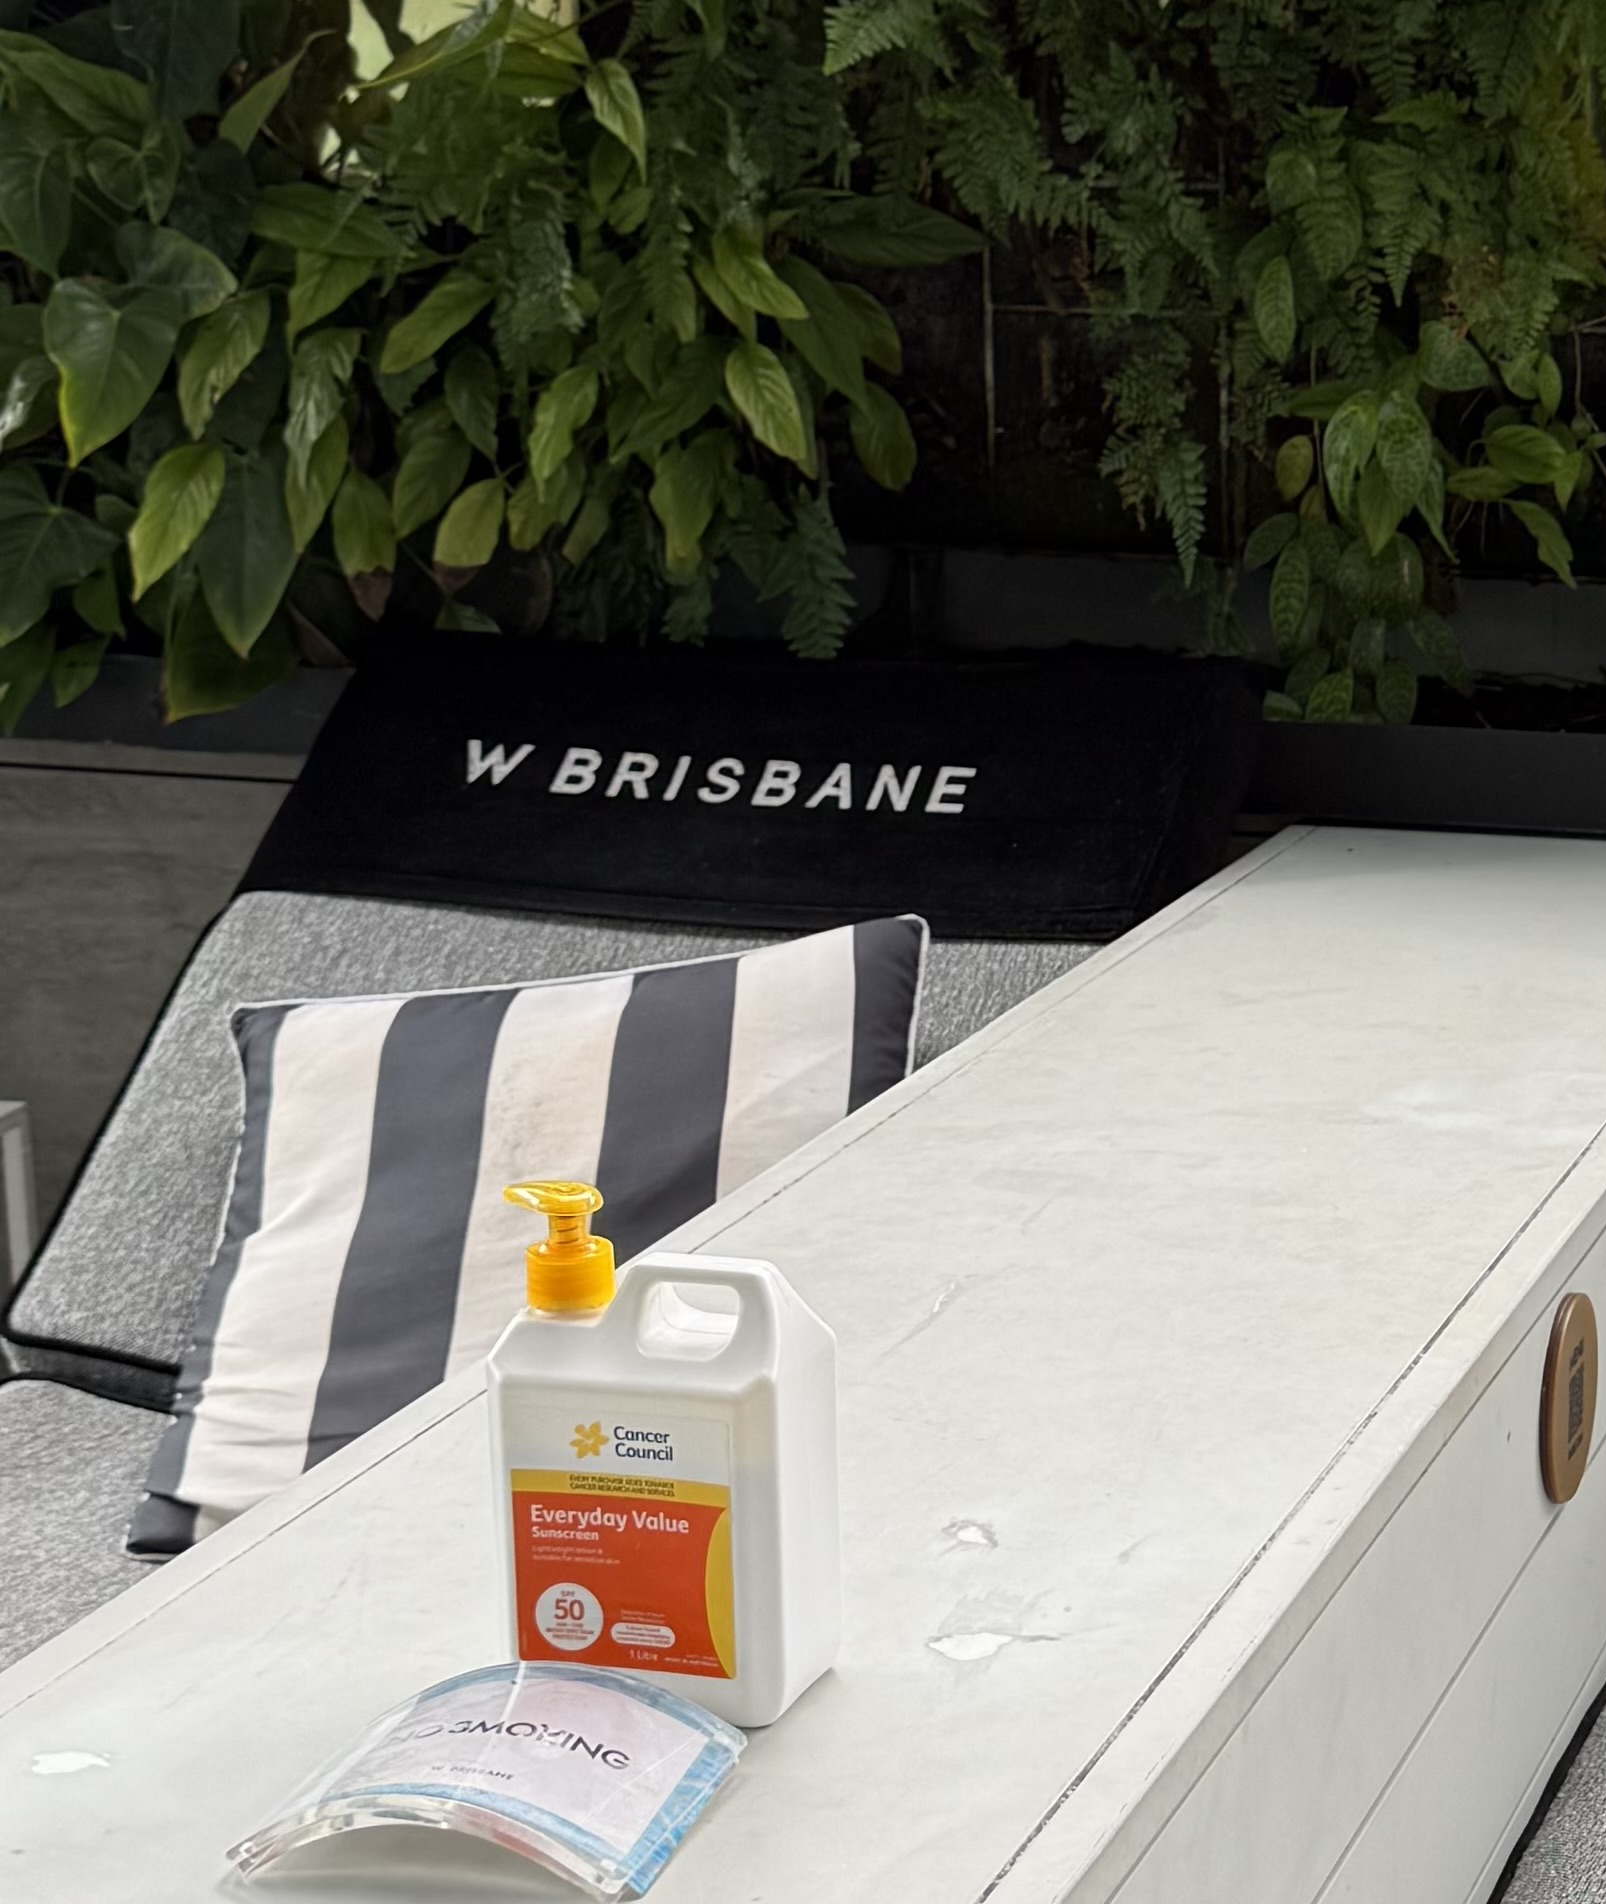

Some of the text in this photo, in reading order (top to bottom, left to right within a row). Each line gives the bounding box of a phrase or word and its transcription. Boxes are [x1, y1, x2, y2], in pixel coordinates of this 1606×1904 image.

[467, 739, 977, 814] W BRISBANE
[613, 1426, 670, 1443] Cancer
[615, 1443, 673, 1461] Council
[530, 1504, 689, 1533] Everyday Value
[531, 1526, 599, 1540] Sunscreen
[554, 1598, 585, 1621] 50
